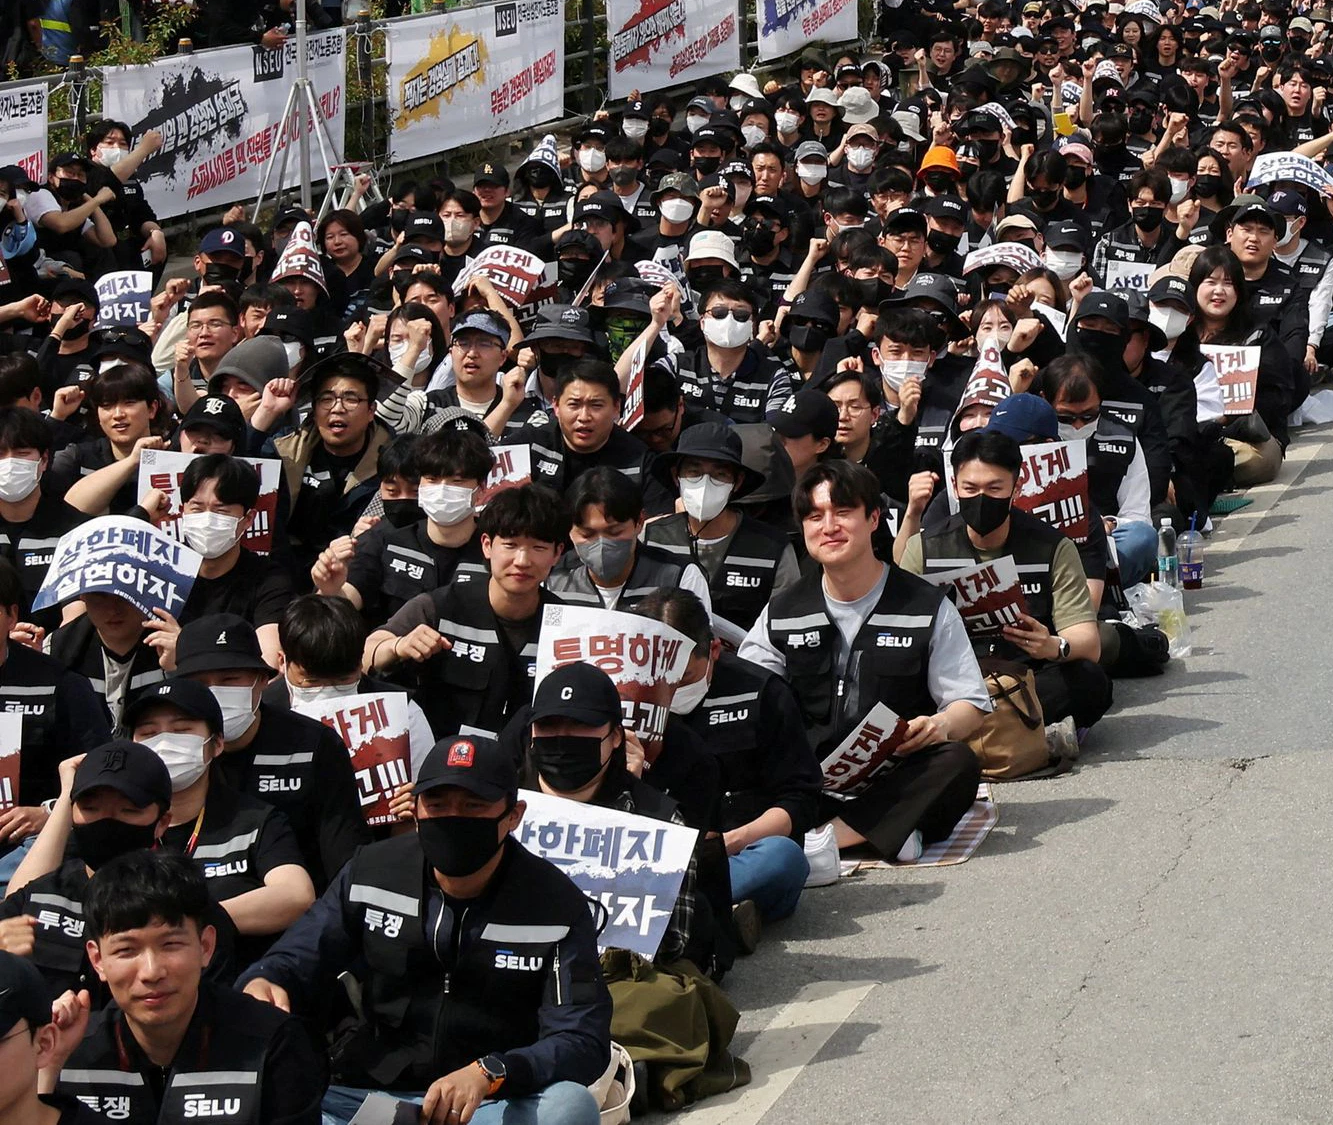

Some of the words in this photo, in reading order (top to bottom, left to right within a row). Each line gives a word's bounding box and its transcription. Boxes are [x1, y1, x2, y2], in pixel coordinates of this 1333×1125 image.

[497, 7, 516, 32] NSEU
[254, 48, 282, 76] NSEU
[285, 36, 343, 64] 전국성전자노동조합
[217, 88, 246, 130] 성과급
[187, 150, 236, 201] 슈퍼사이클
[413, 217, 433, 226] NSEU
[221, 230, 234, 244] D
[489, 234, 508, 243] SELU
[97, 274, 140, 309] 폐지
[94, 301, 149, 322] 하자
[1212, 349, 1247, 375] 하게
[681, 381, 703, 399] 투쟁
[1219, 383, 1252, 405] 고!!!
[733, 395, 759, 408] SELU
[782, 394, 796, 413] LA
[455, 418, 468, 431] LA
[1099, 441, 1127, 455] SELU
[1018, 447, 1072, 487] 하게
[1028, 495, 1084, 528] 고!!!
[24, 552, 53, 565] SELU
[62, 528, 182, 568] 상한폐지
[390, 558, 423, 579] 투쟁
[58, 562, 178, 606] 실현하자
[726, 572, 760, 588] SELU
[944, 565, 1002, 599] 하게
[1020, 583, 1041, 595] ELU
[787, 630, 820, 648] 투쟁
[876, 633, 912, 648] SELU
[451, 640, 485, 663] 투쟁
[552, 632, 682, 675] 투명하게
[561, 686, 572, 700] C
[5, 702, 44, 716] SELU
[321, 697, 390, 742] 하게
[708, 709, 749, 726] SELU
[825, 721, 884, 779] 하게
[258, 776, 301, 792] SELU
[355, 758, 409, 805] 고!!!
[205, 859, 248, 878] SELU
[38, 910, 85, 938] 투쟁
[363, 908, 404, 939] 투쟁
[495, 954, 543, 971] SELU
[183, 1098, 241, 1118] SELU
